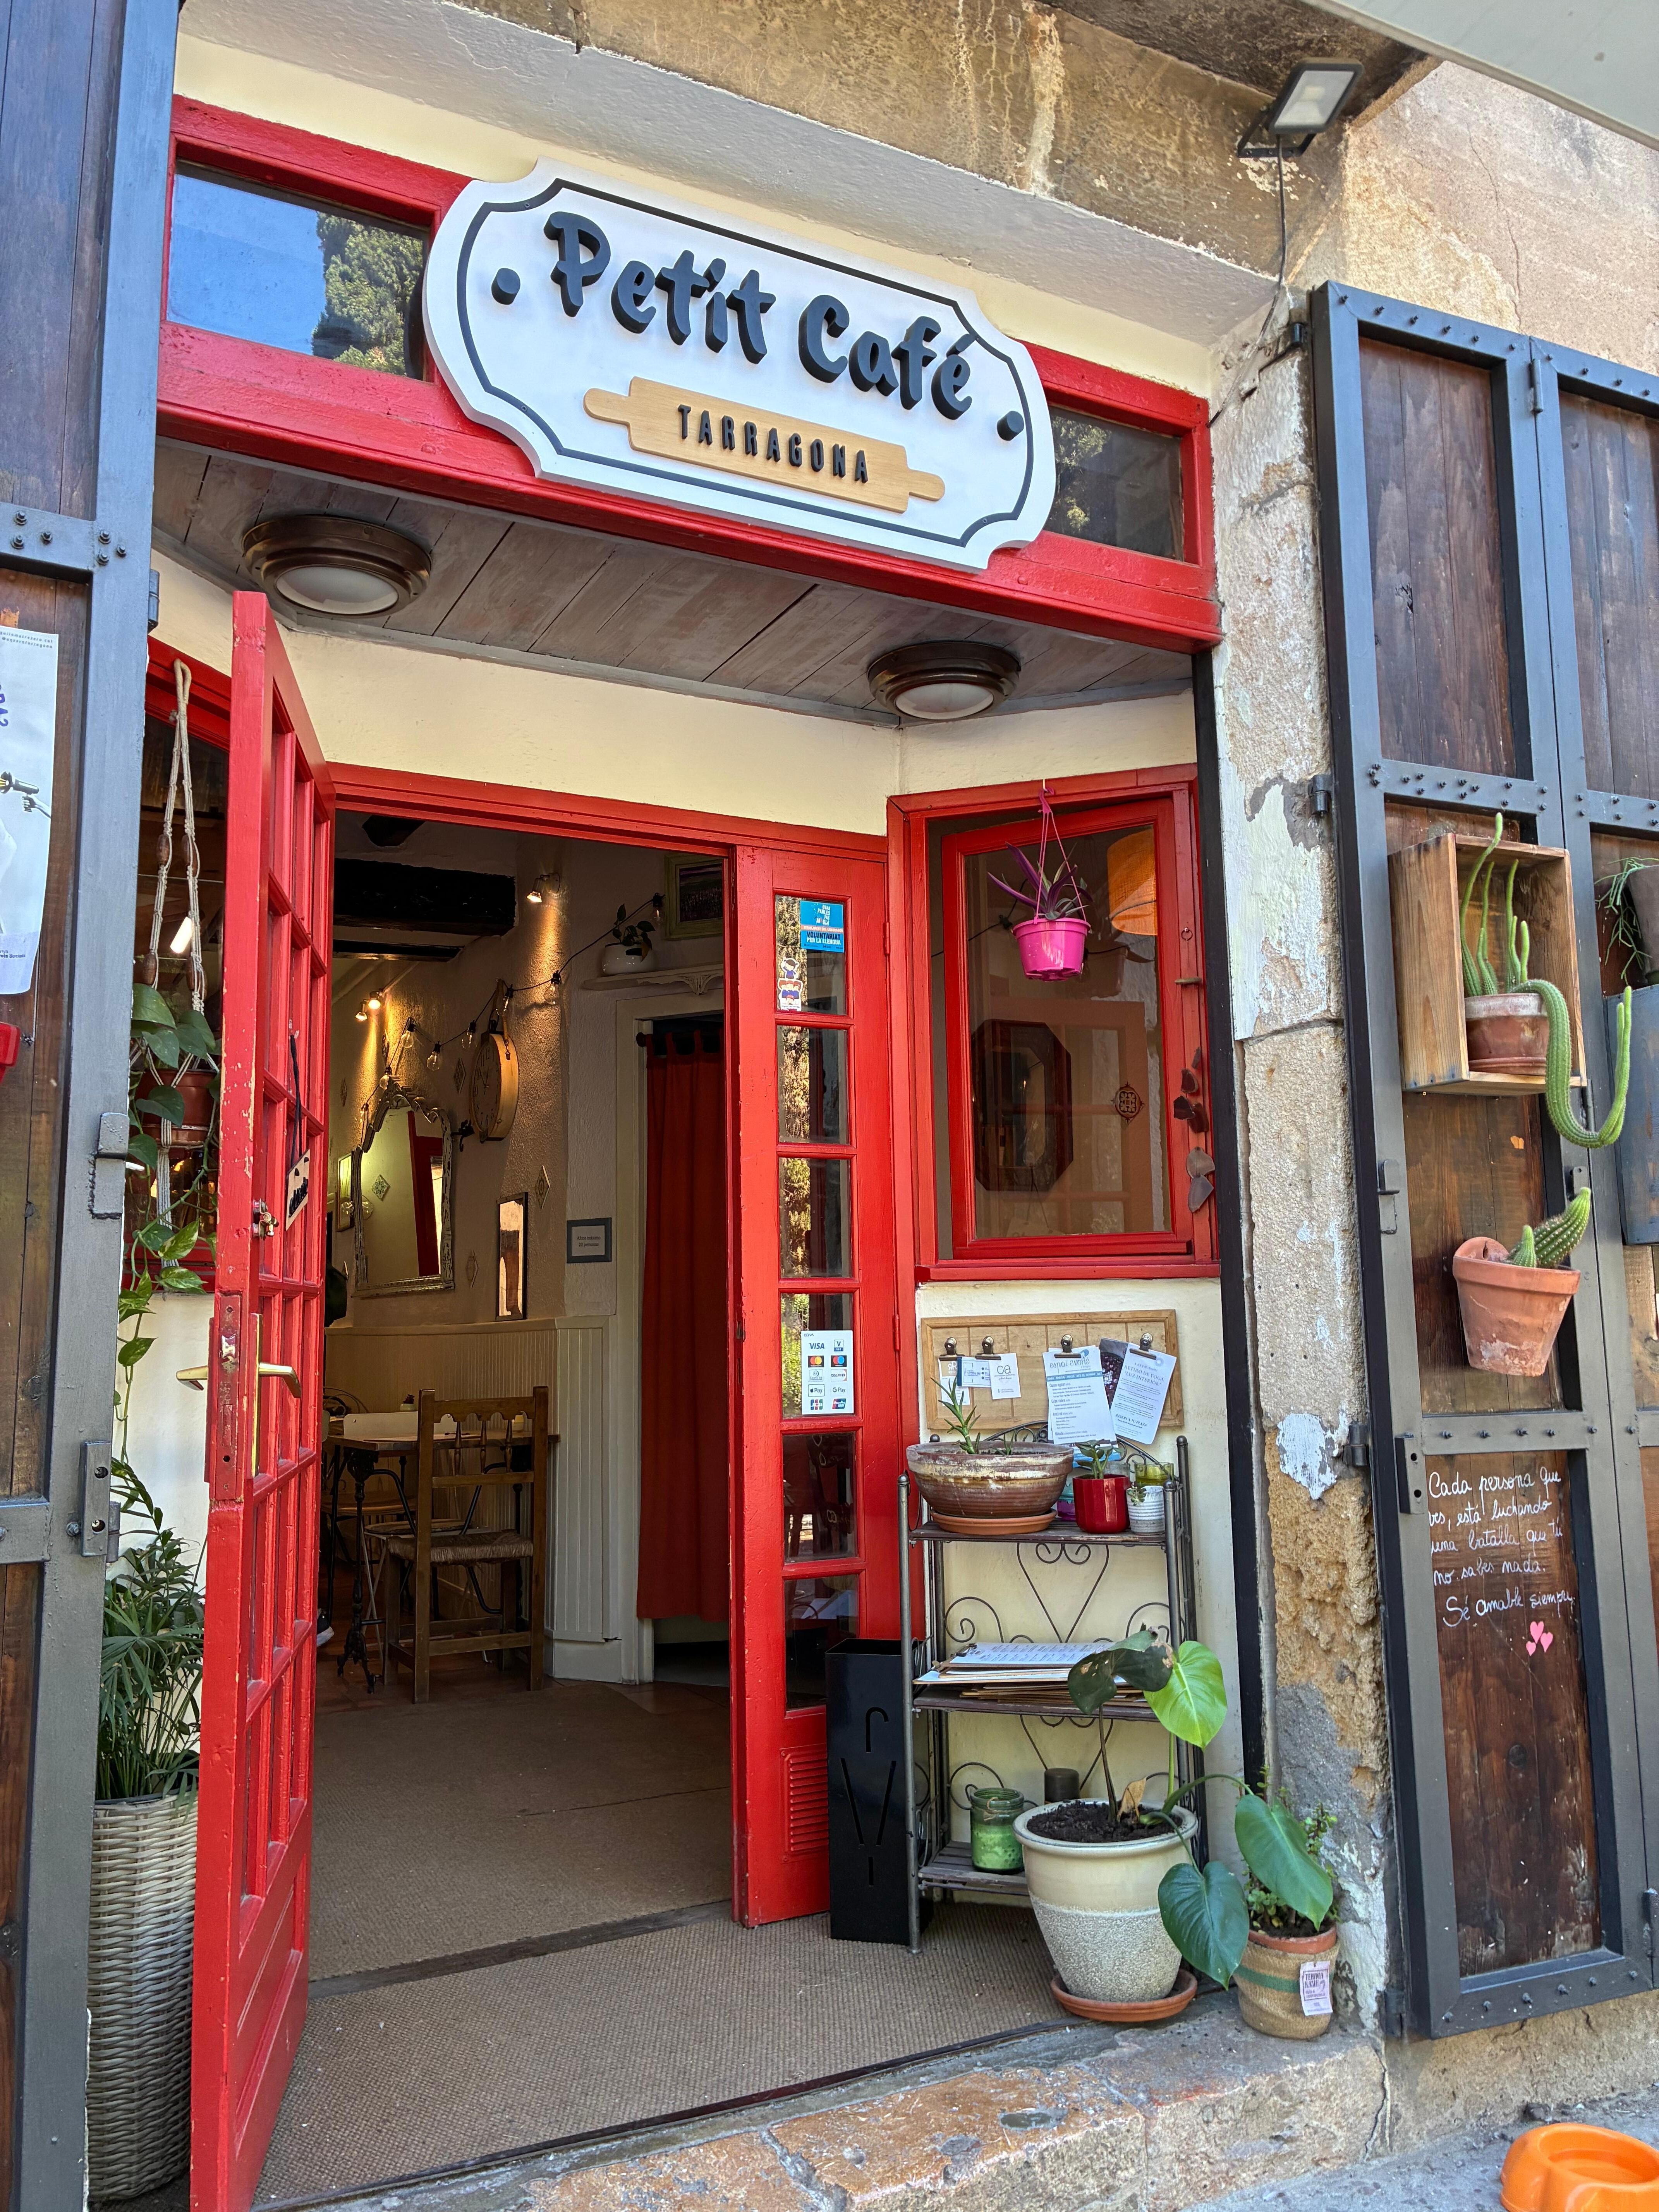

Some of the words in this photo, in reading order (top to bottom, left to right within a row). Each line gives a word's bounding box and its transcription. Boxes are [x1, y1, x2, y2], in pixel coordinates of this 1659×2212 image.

[544, 211, 775, 364] Petit
[799, 294, 972, 420] Café
[678, 404, 869, 483] TARRAGONA
[807, 931, 840, 940] VOLUNTARIAT
[1124, 1365, 1142, 1374] RETIRO
[1150, 1373, 1164, 1382] YOGA
[1429, 1471, 1472, 1498] Cada
[1479, 1473, 1535, 1515] persona
[1456, 1501, 1481, 1527] está
[1491, 1495, 1552, 1520] luchando
[1431, 1540, 1458, 1557] una
[1468, 1524, 1520, 1550] batalla
[1527, 1530, 1547, 1557] que
[1461, 1557, 1494, 1579] sabes
[1443, 1595, 1470, 1627] Sé
[1476, 1587, 1523, 1616] amable
